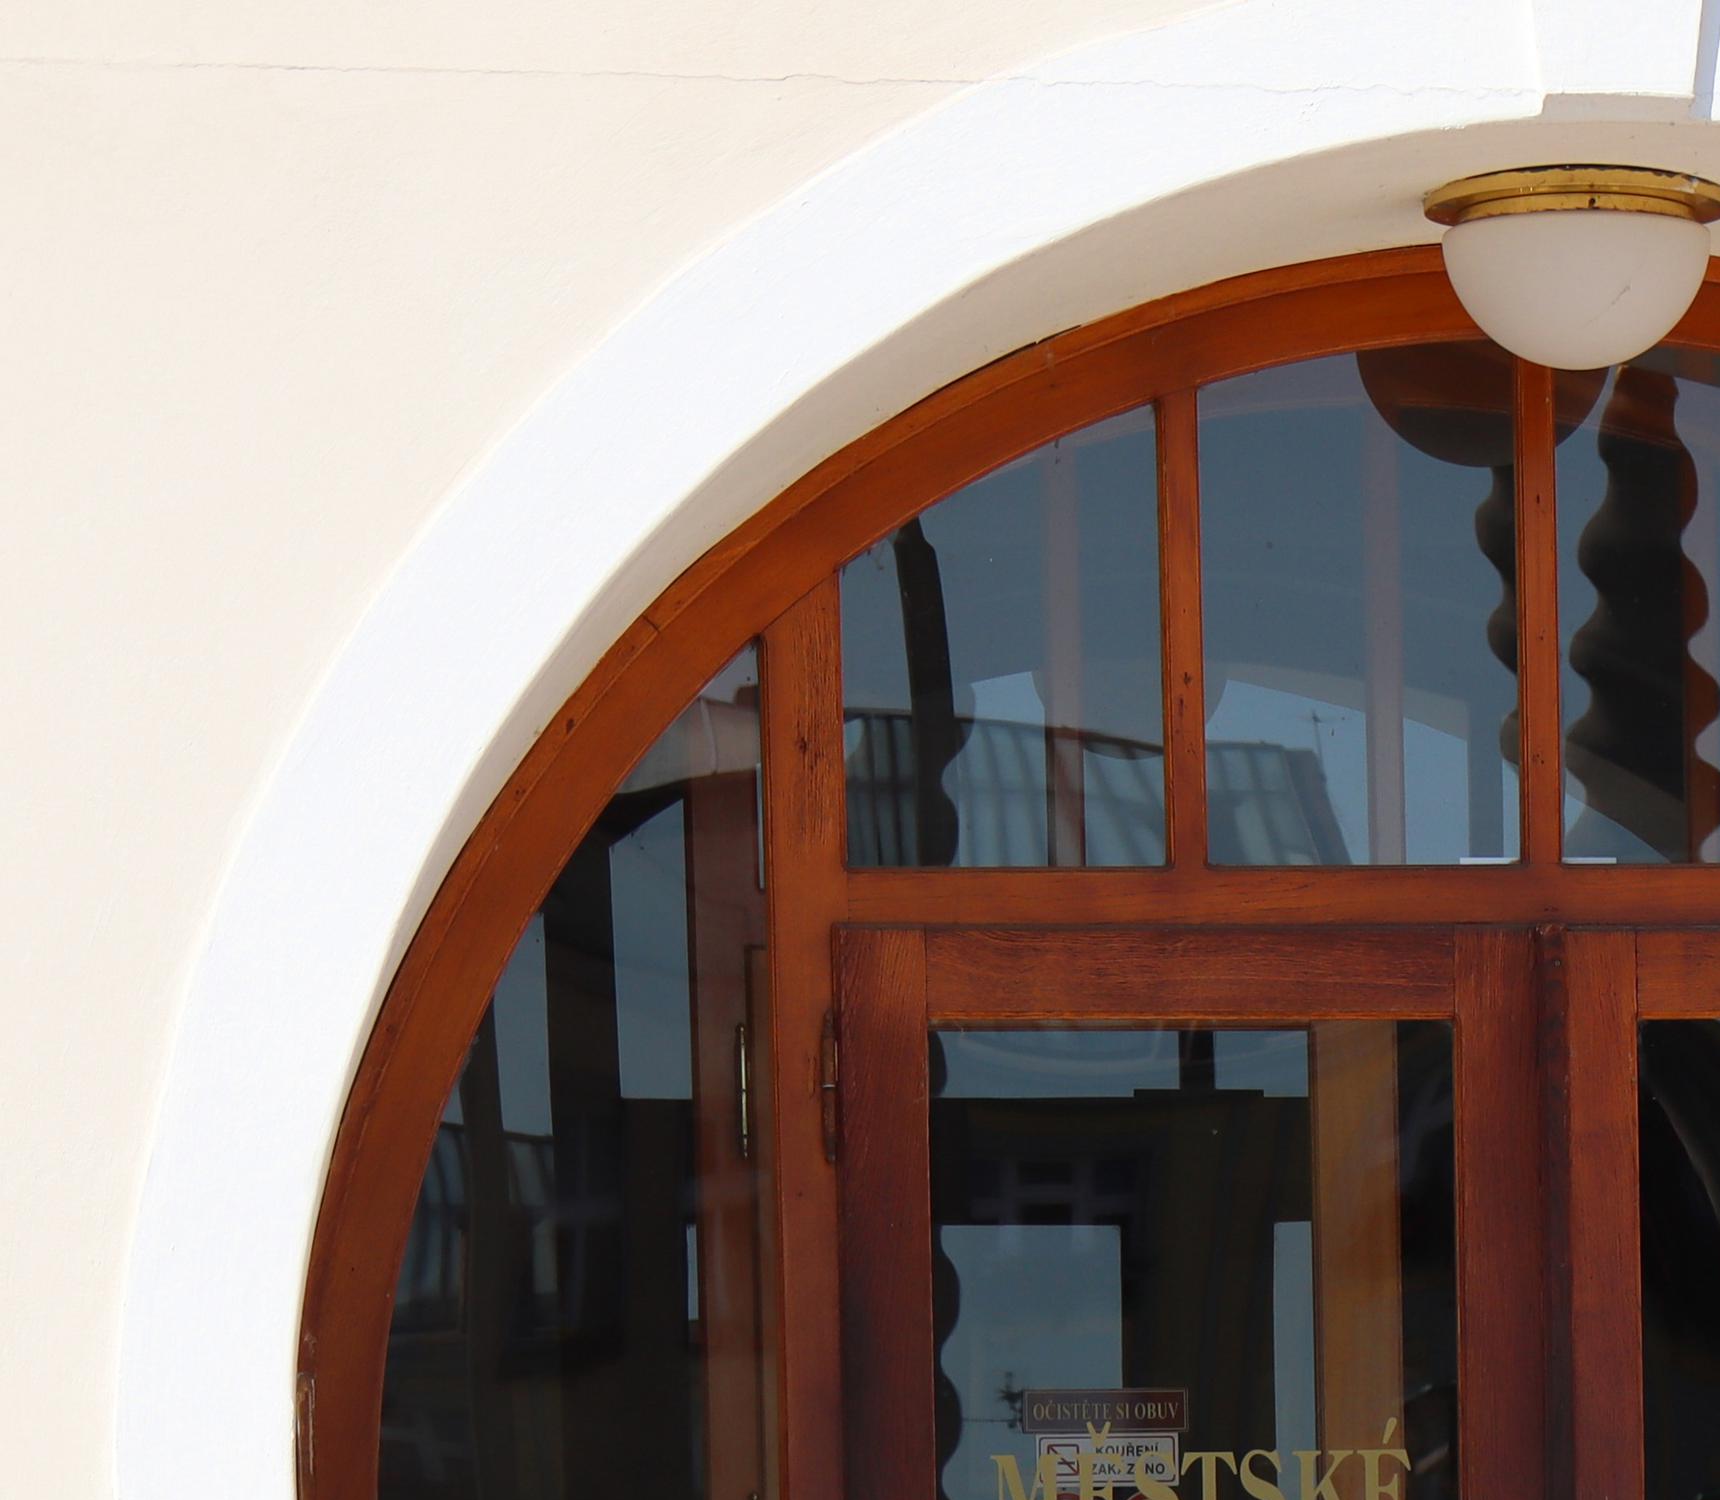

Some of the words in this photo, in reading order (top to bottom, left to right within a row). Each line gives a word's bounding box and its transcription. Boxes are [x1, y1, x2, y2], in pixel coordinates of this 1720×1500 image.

[1033, 1399, 1112, 1421] OČISTĚTE
[1116, 1402, 1129, 1420] SI
[1134, 1401, 1179, 1420] OBUV
[1091, 1462, 1166, 1476] ZAKZNO
